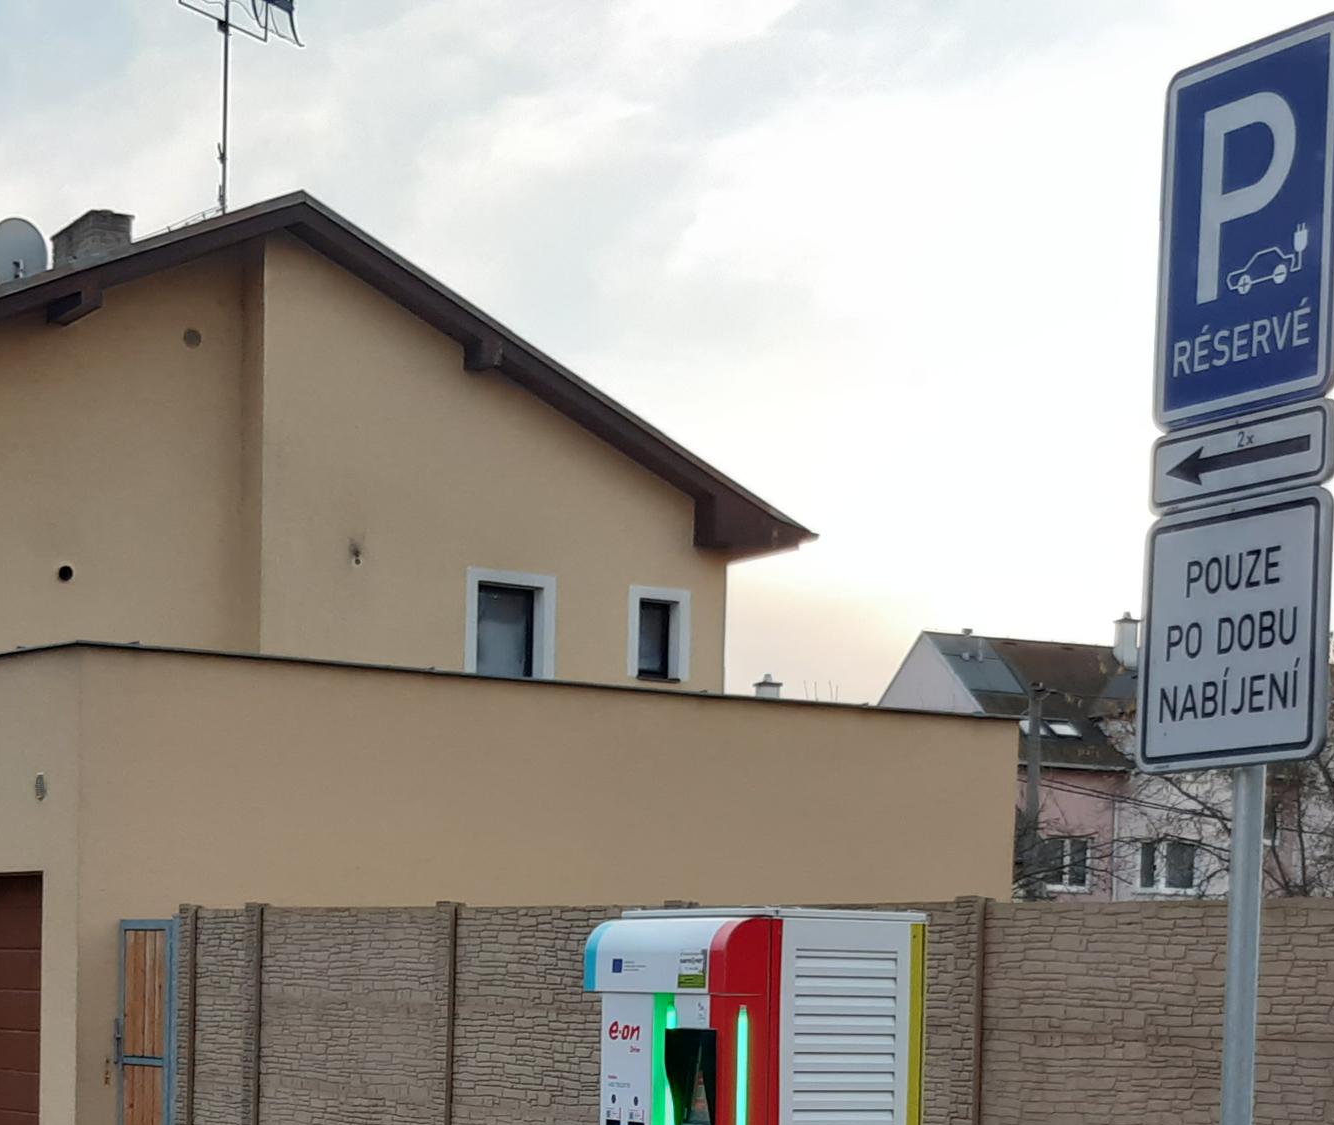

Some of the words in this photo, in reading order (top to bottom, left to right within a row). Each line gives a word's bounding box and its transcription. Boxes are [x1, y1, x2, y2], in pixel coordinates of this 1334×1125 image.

[1196, 91, 1296, 305] P
[1172, 297, 1312, 378] RÉSERVÉ
[1236, 430, 1255, 448] 2x
[1185, 545, 1281, 598] POUZE
[1166, 621, 1203, 662] PO
[1217, 606, 1298, 655] DOBU
[1158, 657, 1301, 723] NABÍJENÍ
